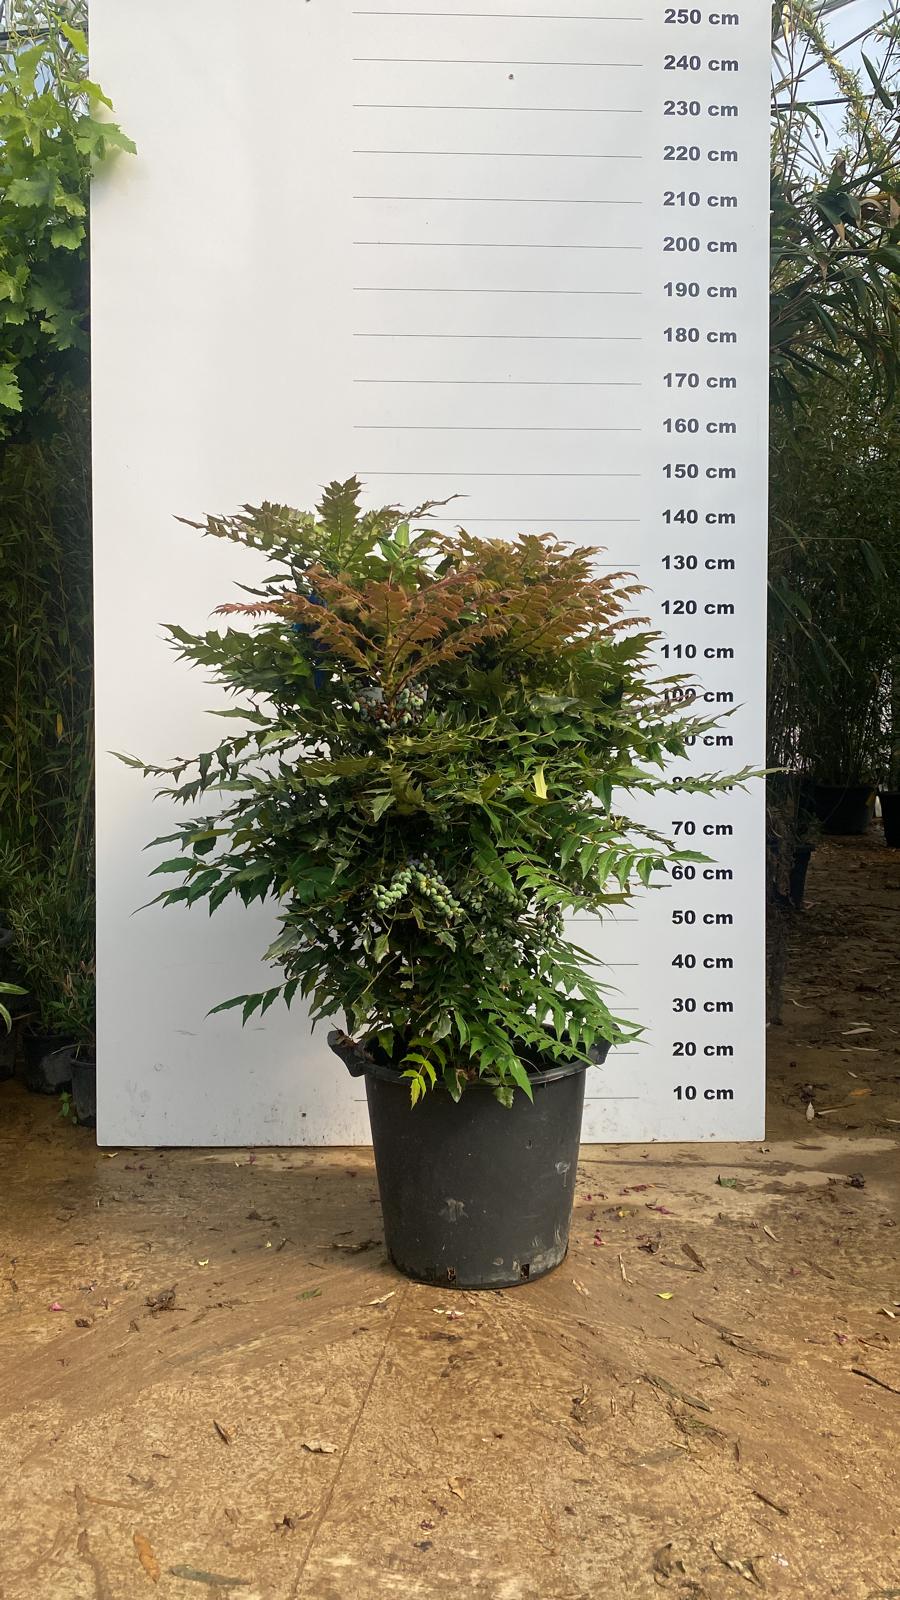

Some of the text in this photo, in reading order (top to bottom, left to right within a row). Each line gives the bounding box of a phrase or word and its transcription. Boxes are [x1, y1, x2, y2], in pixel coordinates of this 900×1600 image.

[665, 9, 738, 25] 250 cm
[664, 55, 738, 71] 240 cm
[664, 101, 737, 116] 230 cm
[664, 146, 737, 161] 220 cm
[664, 192, 737, 207] 210 cm
[664, 237, 736, 252] 200 cm
[664, 282, 736, 297] 190 cm
[663, 328, 736, 342] 180 cm
[663, 373, 736, 387] 170 cm
[663, 419, 736, 433] 160 cm
[663, 464, 735, 478] 150 cm
[663, 510, 735, 524] 140 cm
[662, 555, 734, 569] 130 cm
[662, 600, 734, 614] 120 cm
[661, 644, 733, 658] 110 cm
[704, 691, 733, 702] cm
[703, 735, 733, 746] cm
[672, 821, 732, 835] 70 cm
[672, 866, 732, 880] 60 cm
[672, 910, 732, 924] 50 cm
[672, 954, 733, 968] 40 cm
[673, 998, 733, 1012] 30 cm
[673, 1042, 733, 1056] 20 cm
[674, 1086, 733, 1100] 10 cm
